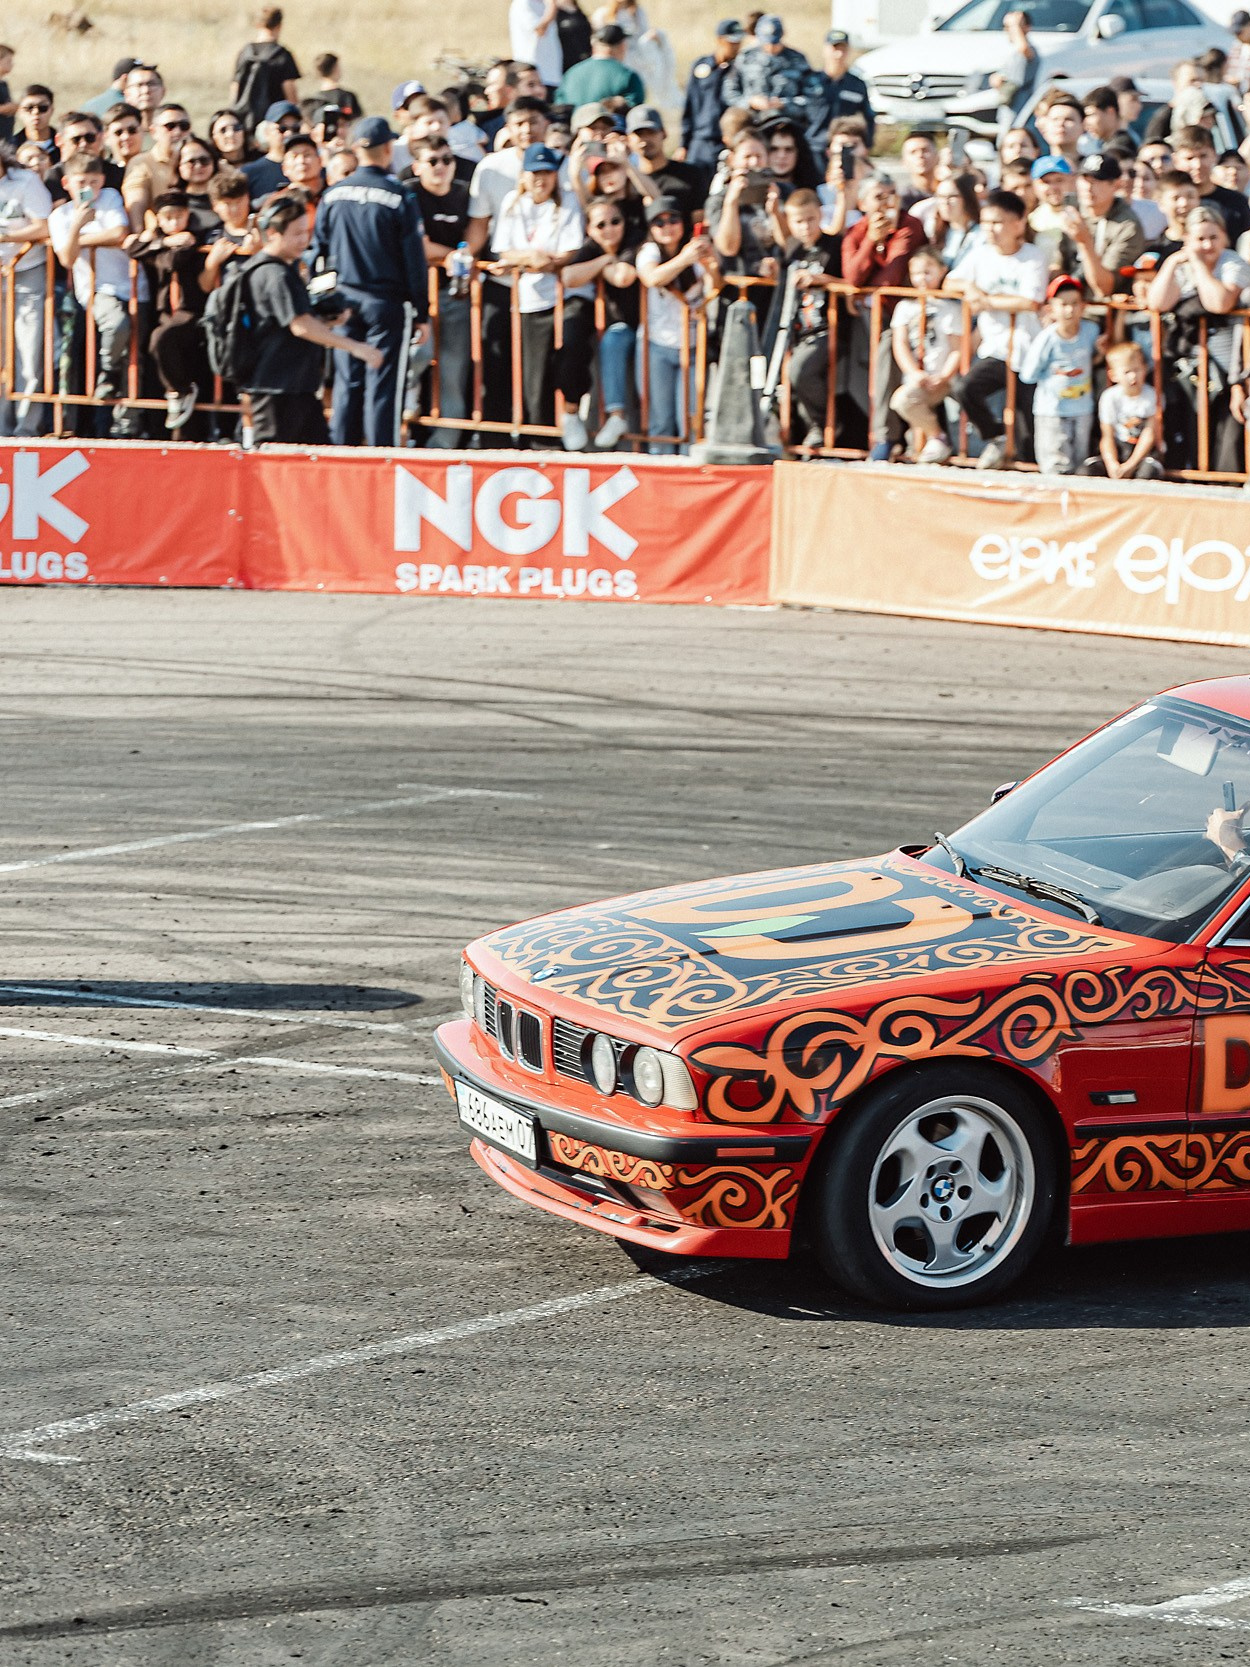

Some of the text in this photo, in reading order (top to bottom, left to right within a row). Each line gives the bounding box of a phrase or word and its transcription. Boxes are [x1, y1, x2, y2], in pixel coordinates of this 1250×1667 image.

[0, 450, 91, 544] K
[394, 464, 640, 561] NGK
[395, 562, 639, 598] SPARK PLUGS
